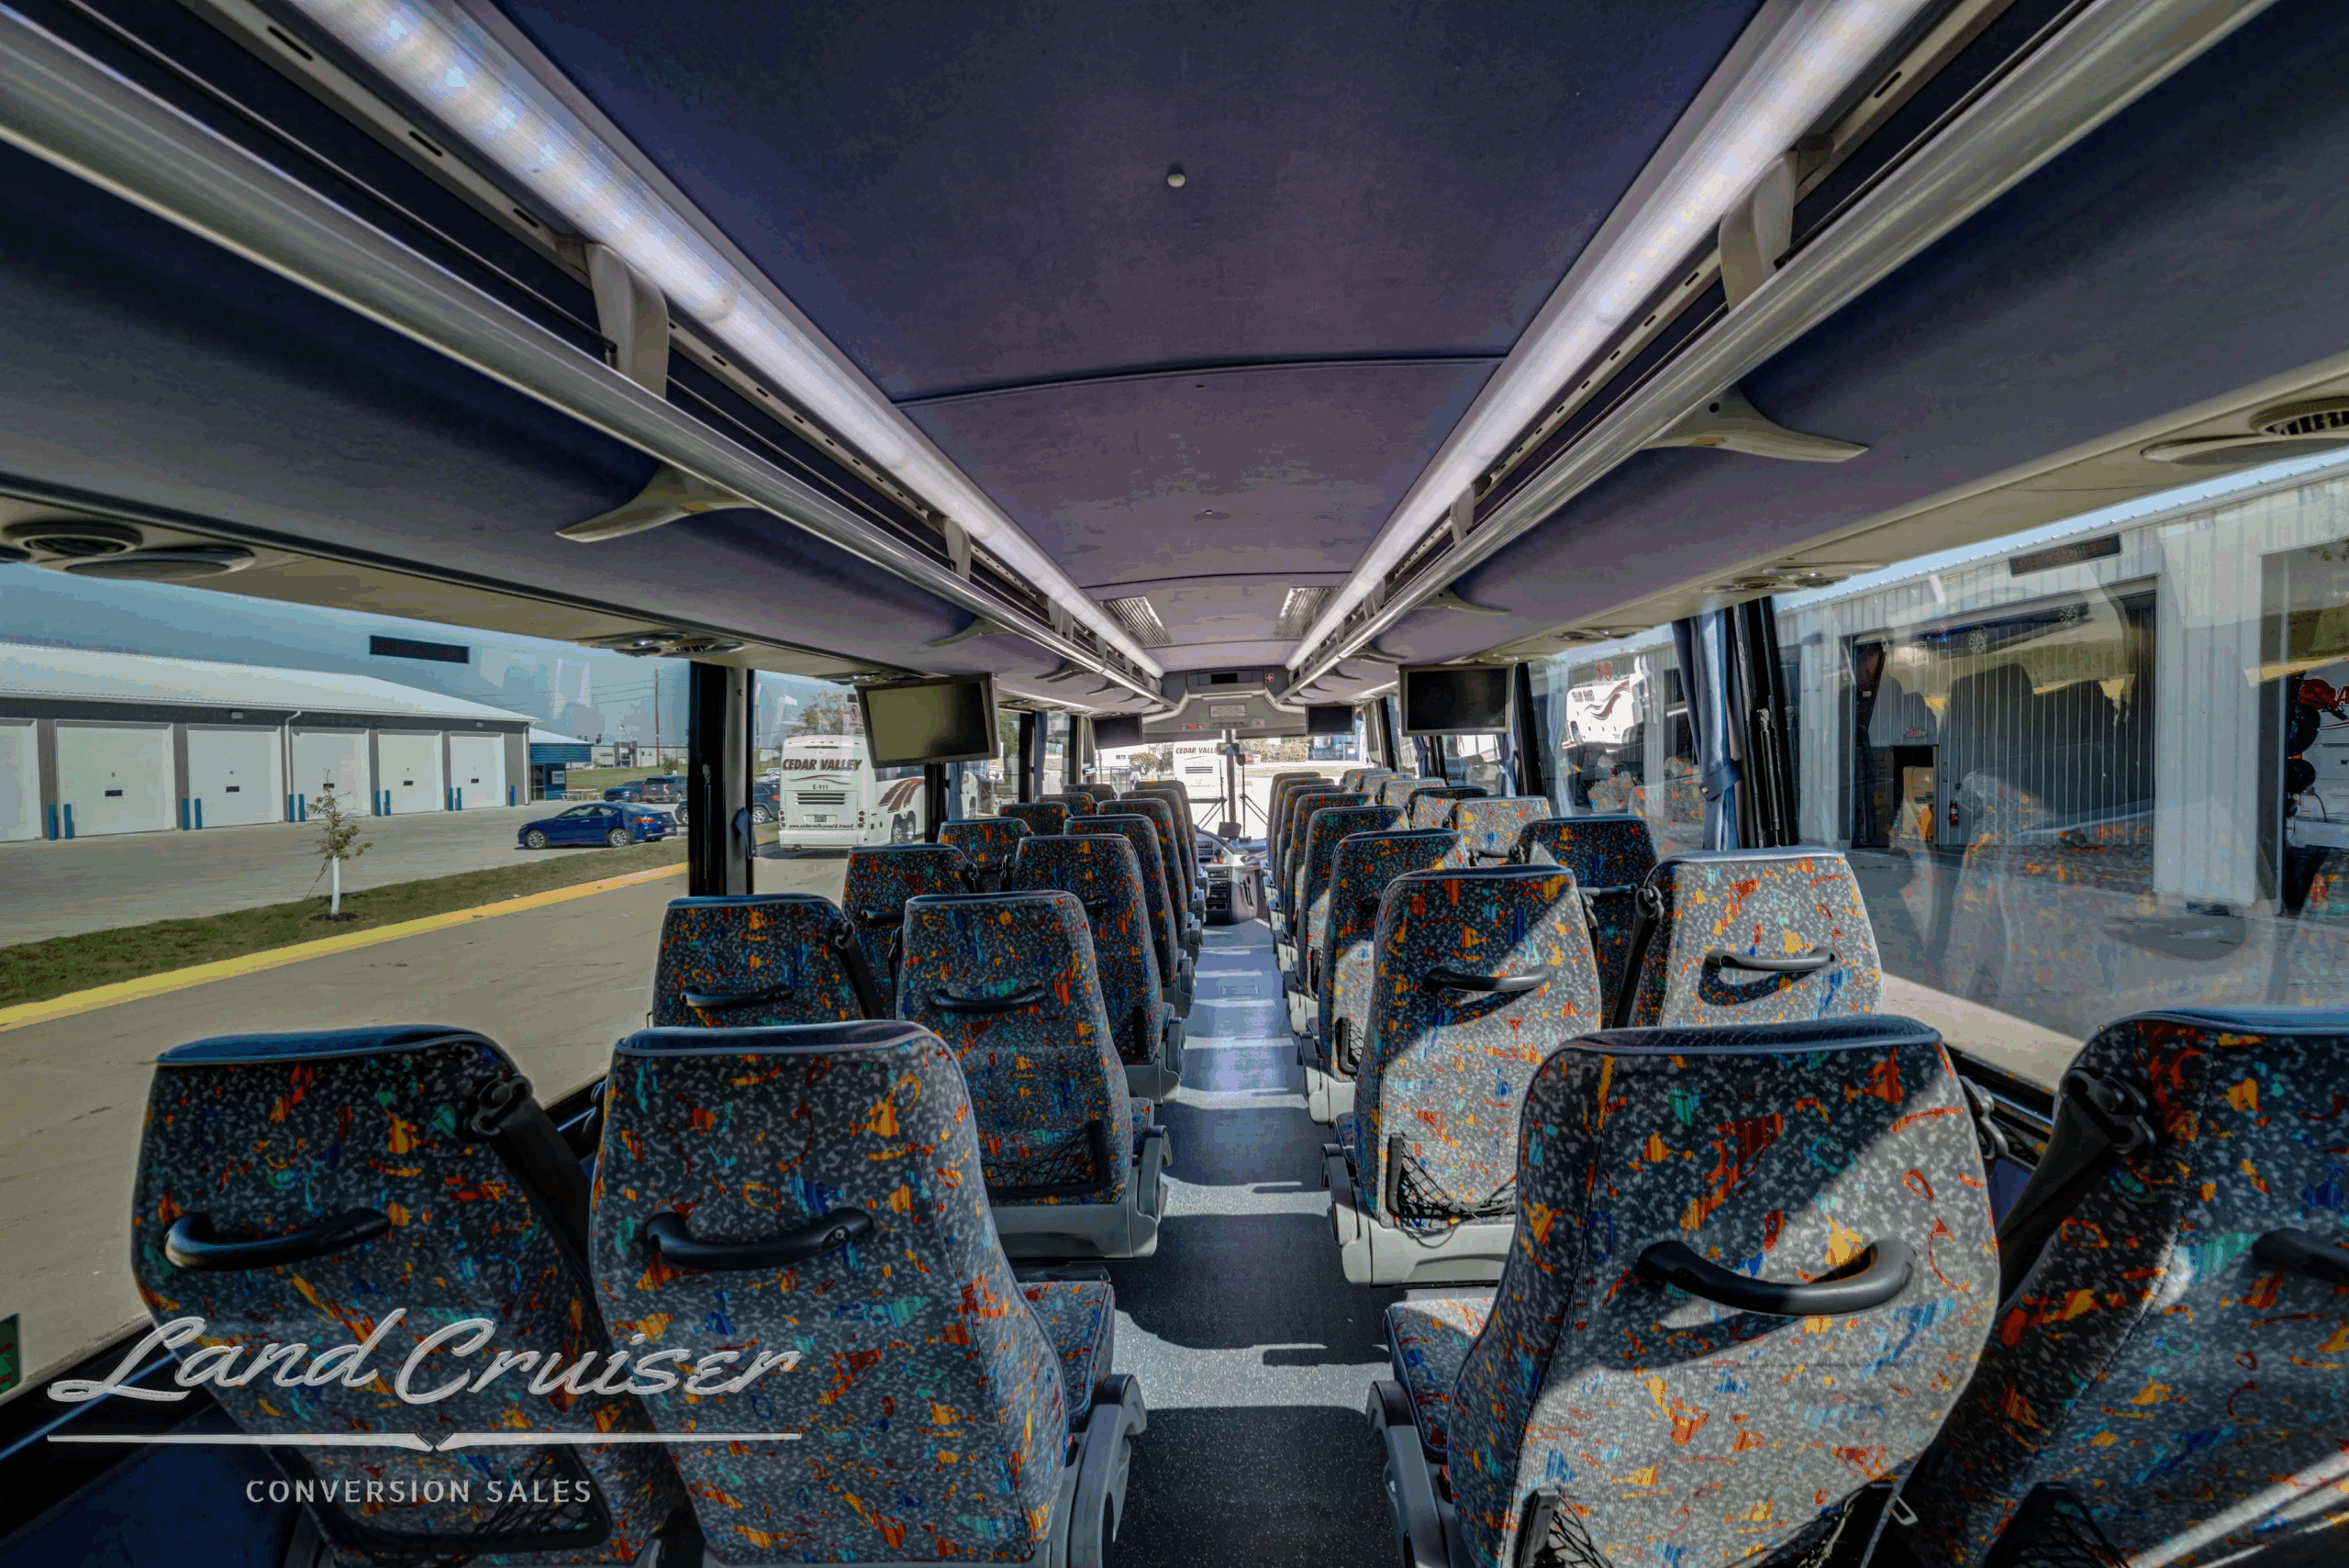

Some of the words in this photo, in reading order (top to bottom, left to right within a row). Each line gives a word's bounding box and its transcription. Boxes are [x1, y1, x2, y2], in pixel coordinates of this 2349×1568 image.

[2014, 545, 2081, 572] EMERGENCY
[2085, 538, 2110, 556] EXIT
[782, 759, 818, 771] CEDAR
[819, 759, 863, 771] VALLEY
